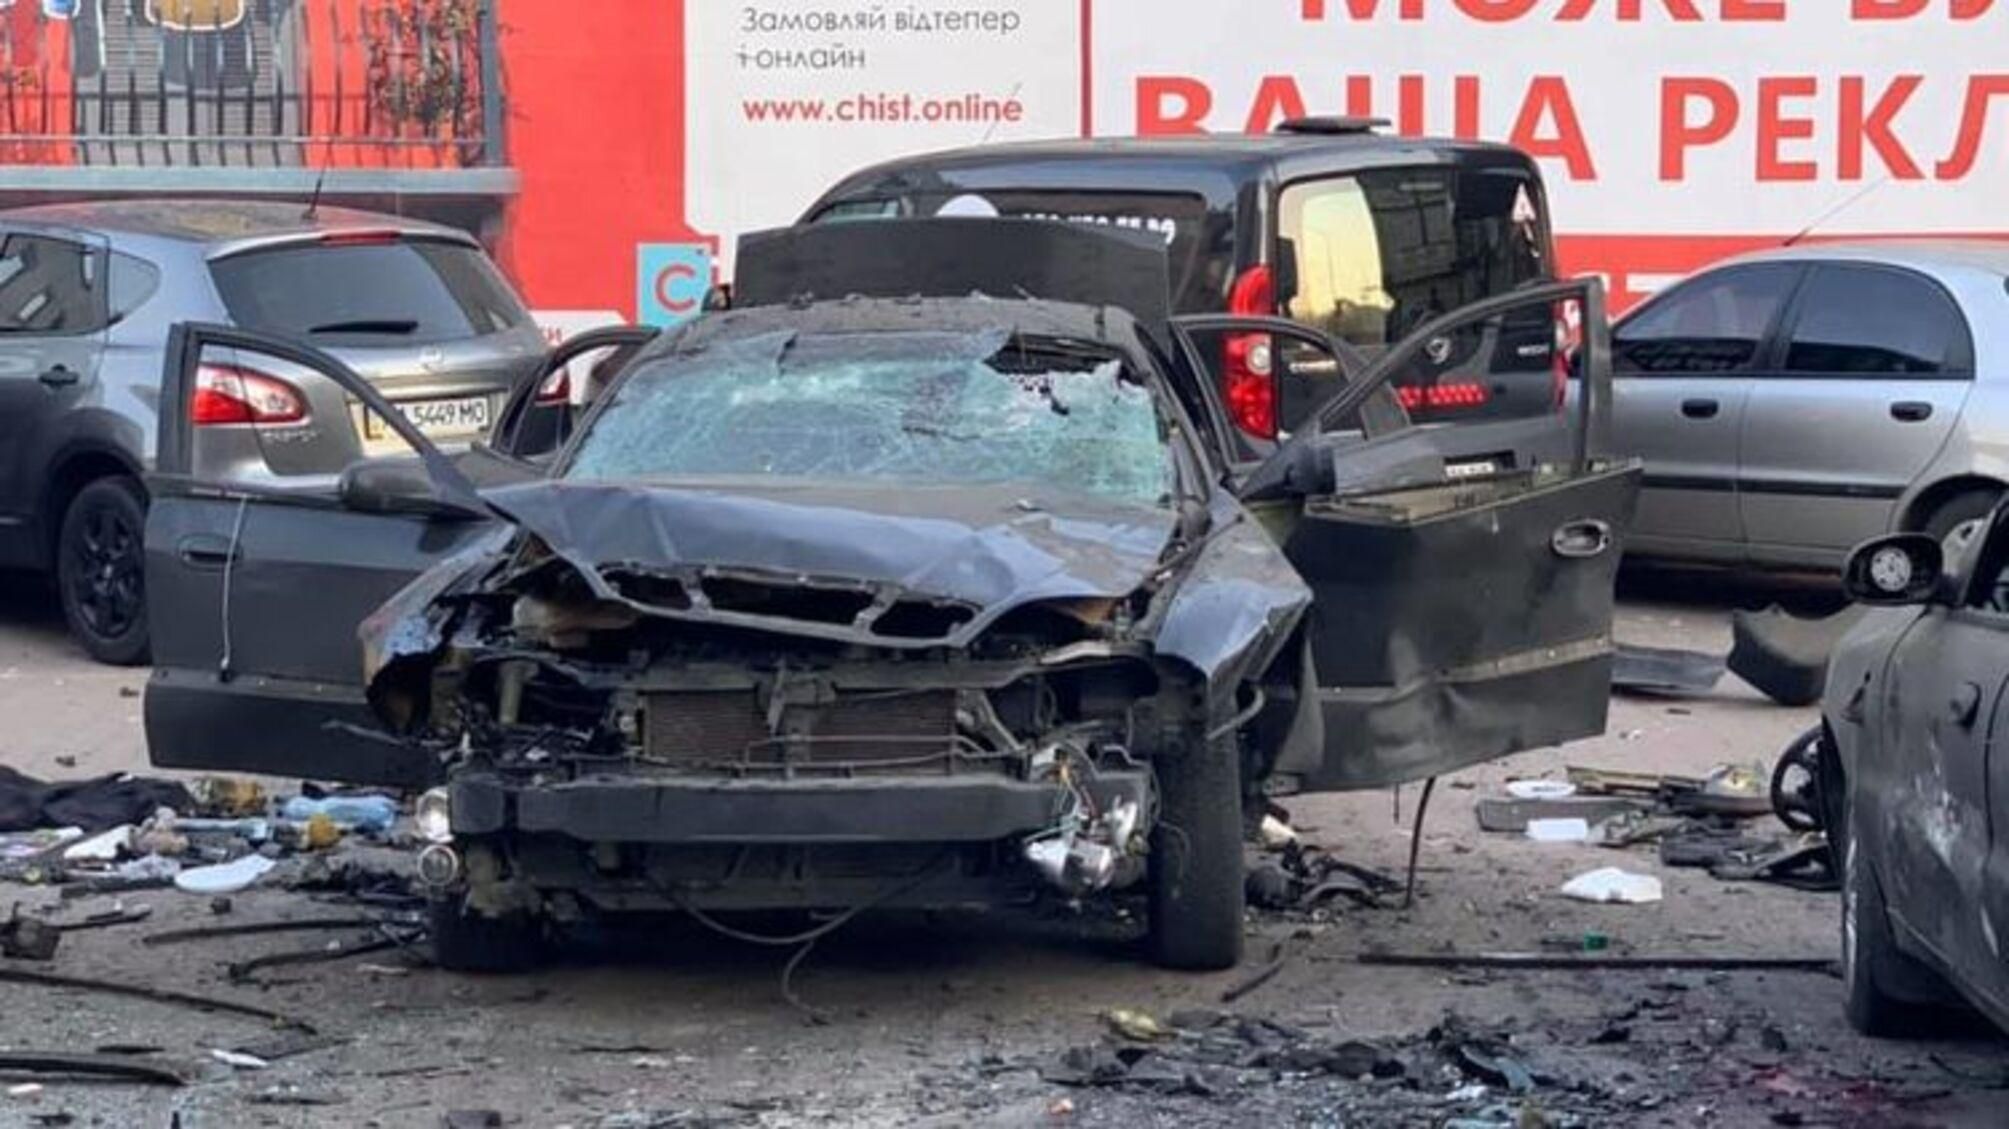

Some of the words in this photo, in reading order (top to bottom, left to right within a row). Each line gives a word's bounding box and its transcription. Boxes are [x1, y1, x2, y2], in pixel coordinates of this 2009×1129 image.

[742, 7, 887, 32] Замовляй
[895, 6, 1019, 34] відтепер
[742, 94, 1023, 122] www.chist.online
